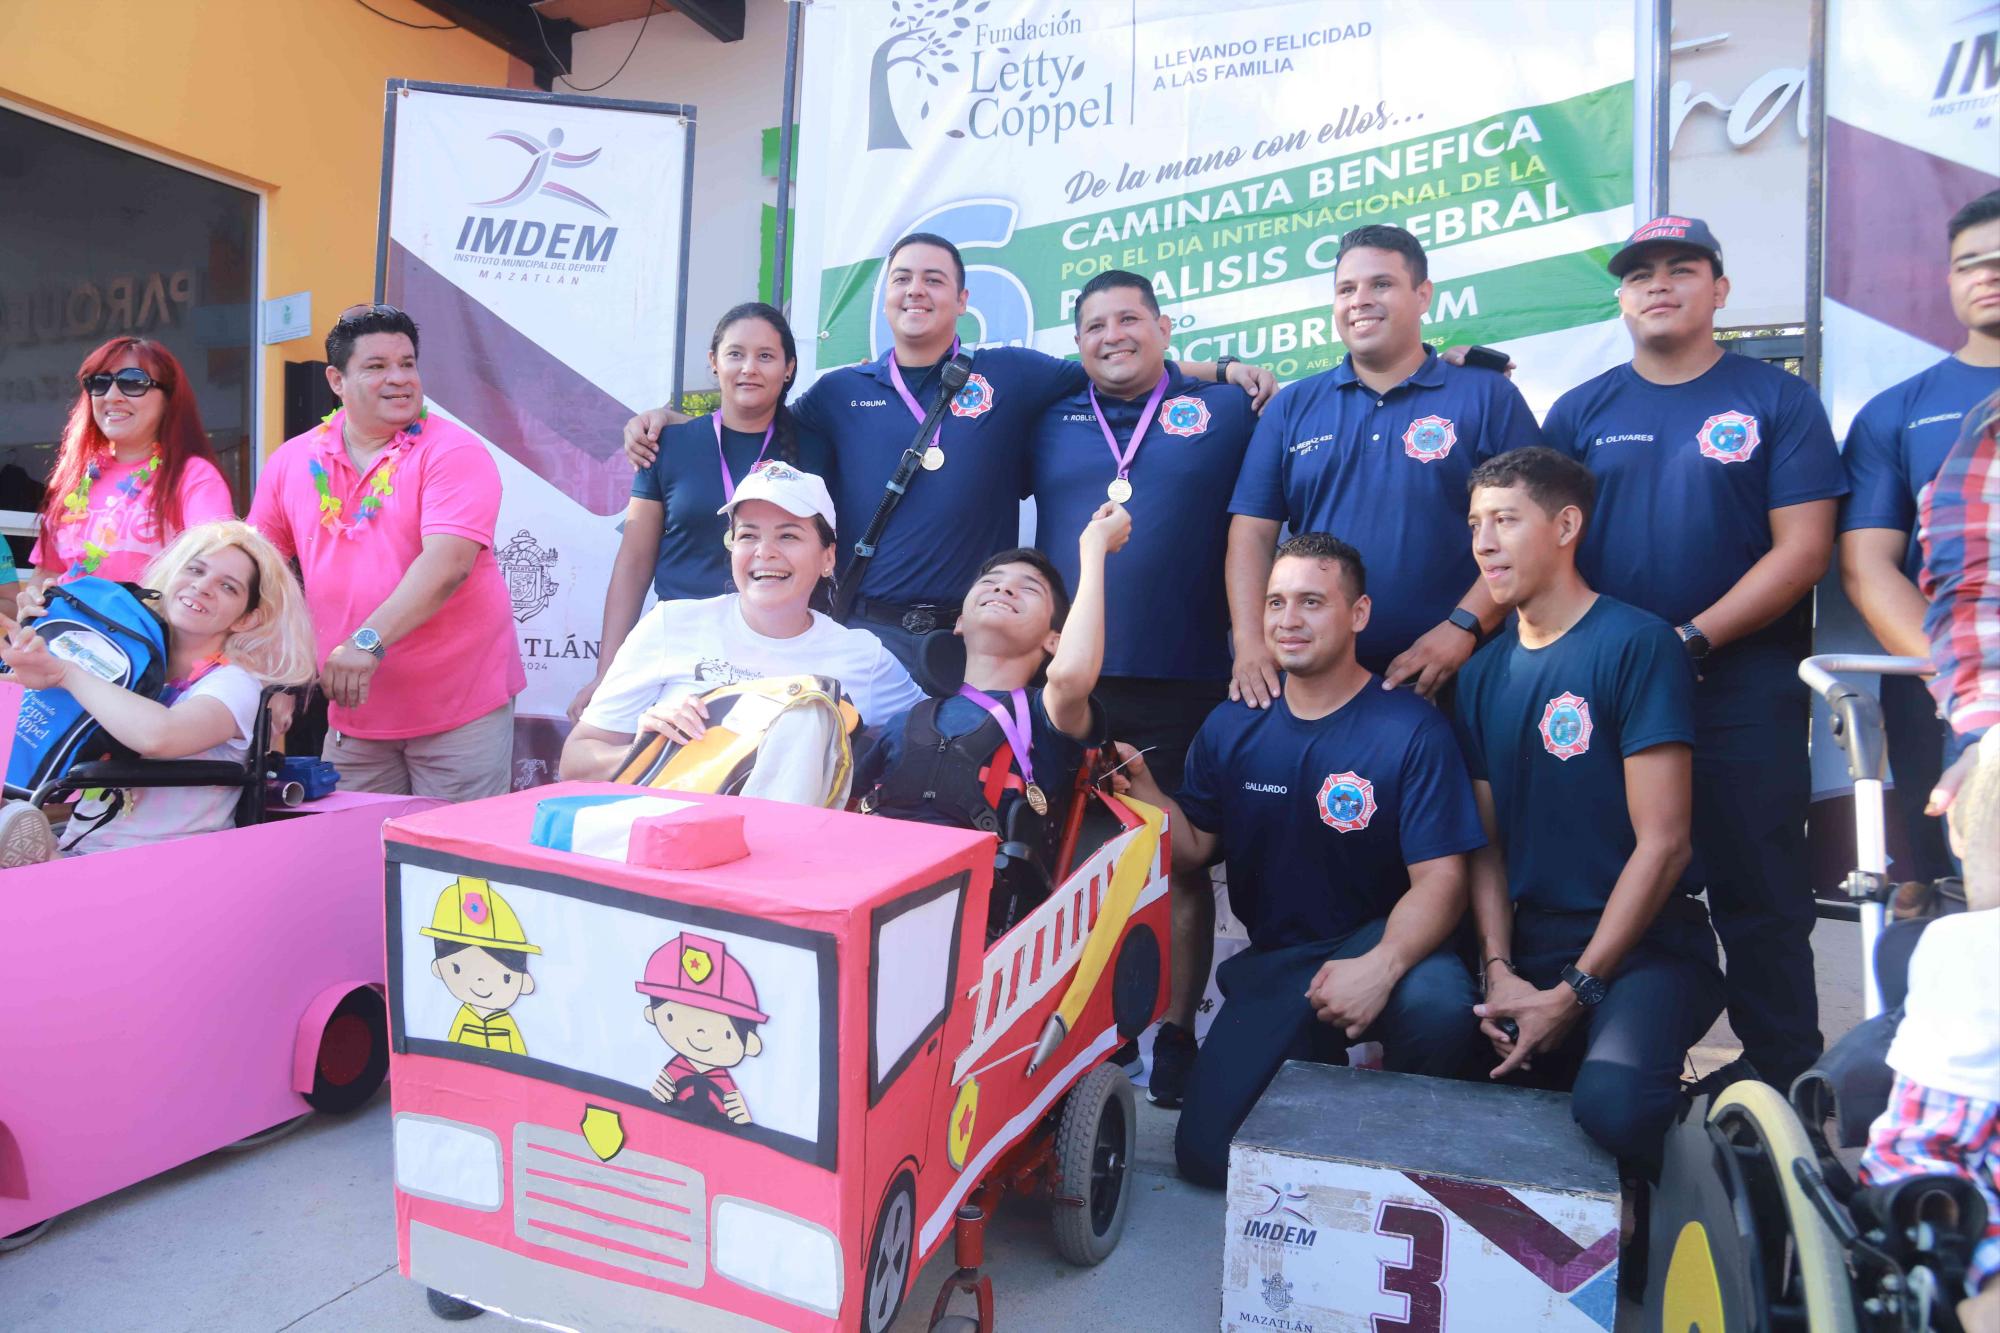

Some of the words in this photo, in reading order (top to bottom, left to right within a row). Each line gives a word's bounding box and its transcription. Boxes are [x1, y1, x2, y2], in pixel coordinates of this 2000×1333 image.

[976, 9, 1082, 46] Fundación
[1154, 39, 1257, 70] LLEVANDO
[1264, 21, 1372, 53] FELICIDAD
[969, 50, 1075, 98] Letty
[1152, 75, 1166, 91] A
[1172, 68, 1208, 88] LAS
[1214, 57, 1294, 81] FAMILIA
[968, 82, 1114, 146] Coppel
[1065, 170, 1111, 204] De
[1116, 162, 1150, 193] la
[1155, 146, 1247, 184] mano
[1252, 129, 1311, 160] con
[1317, 100, 1424, 144] ellos...
[1062, 177, 1294, 251] CAMINATA
[1309, 114, 1543, 199] BENEFICA
[456, 216, 618, 262] IMDEM
[1061, 254, 1114, 280] POR
[1123, 247, 1149, 267] EL
[1157, 237, 1203, 261] DIA
[1213, 179, 1452, 249] INTERNACIONAL
[1461, 167, 1500, 193] DE
[1510, 155, 1547, 182] LA
[453, 253, 499, 266] INSTITUTO
[500, 258, 549, 270] MUNICIPAL
[550, 262, 568, 271] DEL
[568, 263, 606, 273] DEPORTE
[1060, 245, 1288, 321] PALISIS
[1304, 182, 1569, 270] CEBRAL
[1306, 357, 1333, 370] AVE.
[860, 399, 887, 408] OSUNA
[1605, 434, 1654, 444] OLIVARES
[1245, 781, 1288, 795] GALLARDO
[1243, 1220, 1317, 1246] IMDEM
[1371, 1200, 1449, 1333] 3
